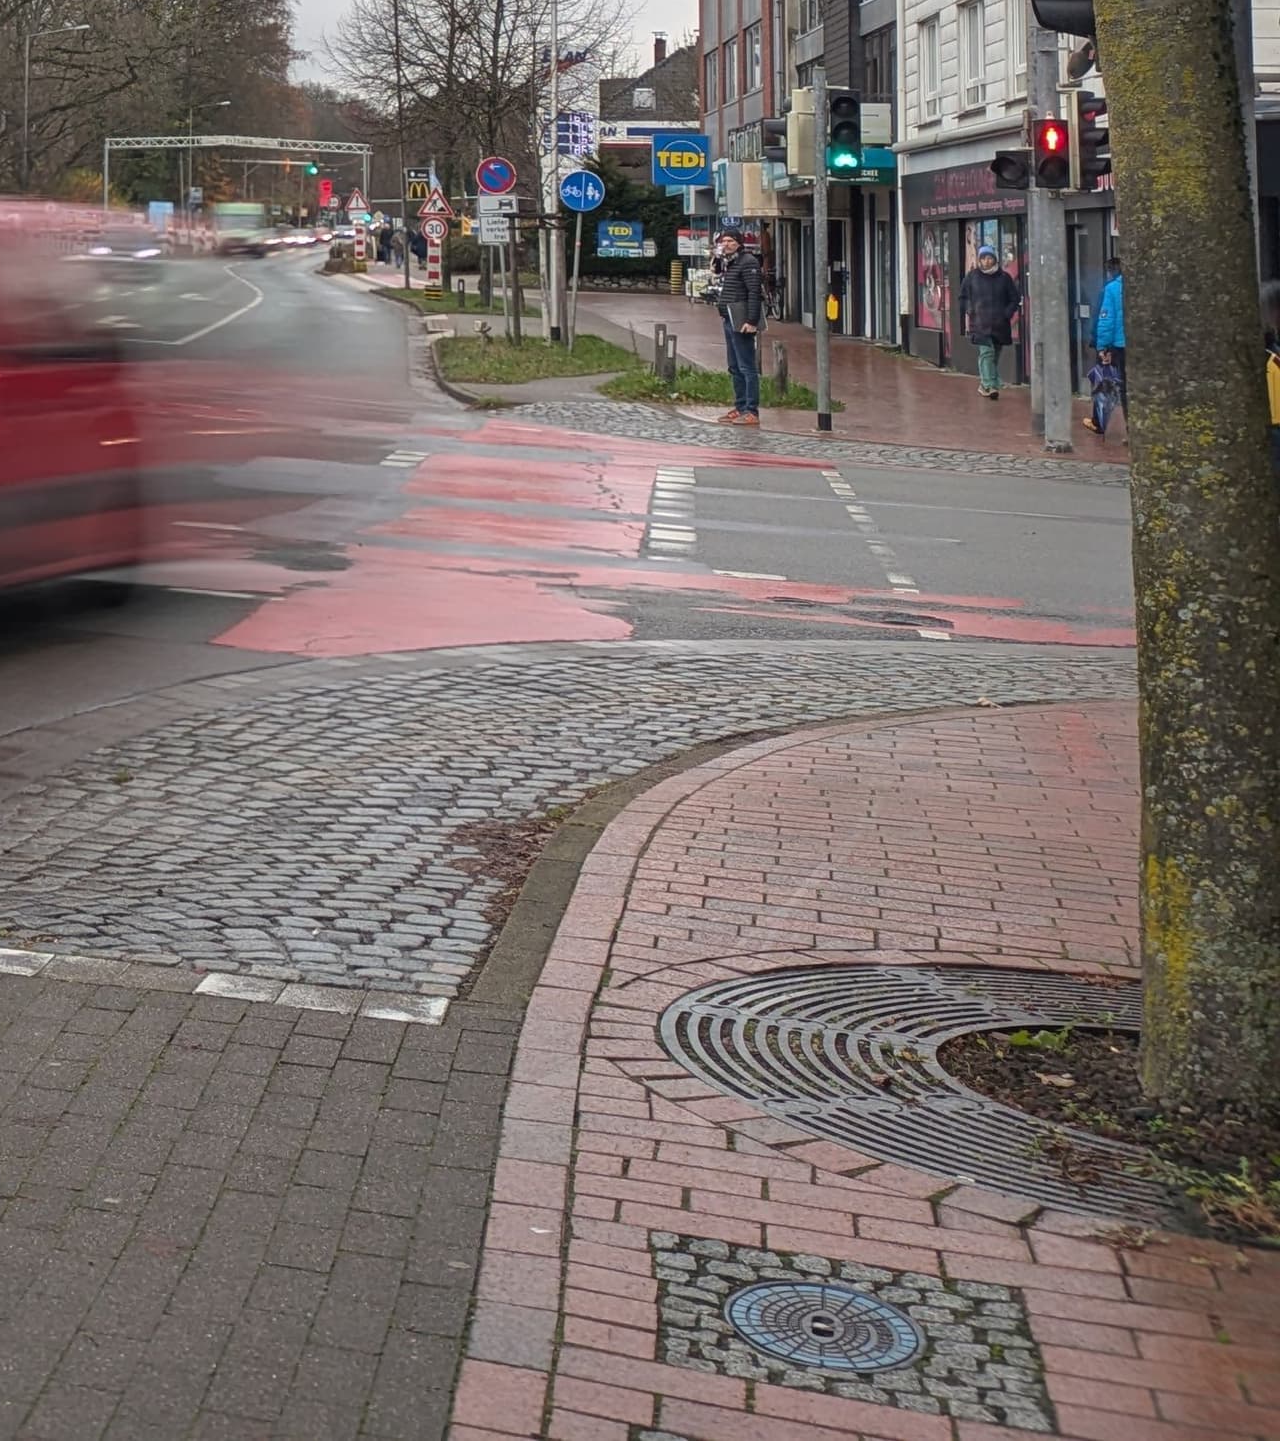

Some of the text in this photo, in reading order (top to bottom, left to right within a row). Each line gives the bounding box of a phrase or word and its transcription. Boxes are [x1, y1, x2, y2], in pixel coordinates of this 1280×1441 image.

[656, 151, 705, 168] TEDi
[427, 224, 442, 235] 30
[607, 226, 633, 236] TEDi
